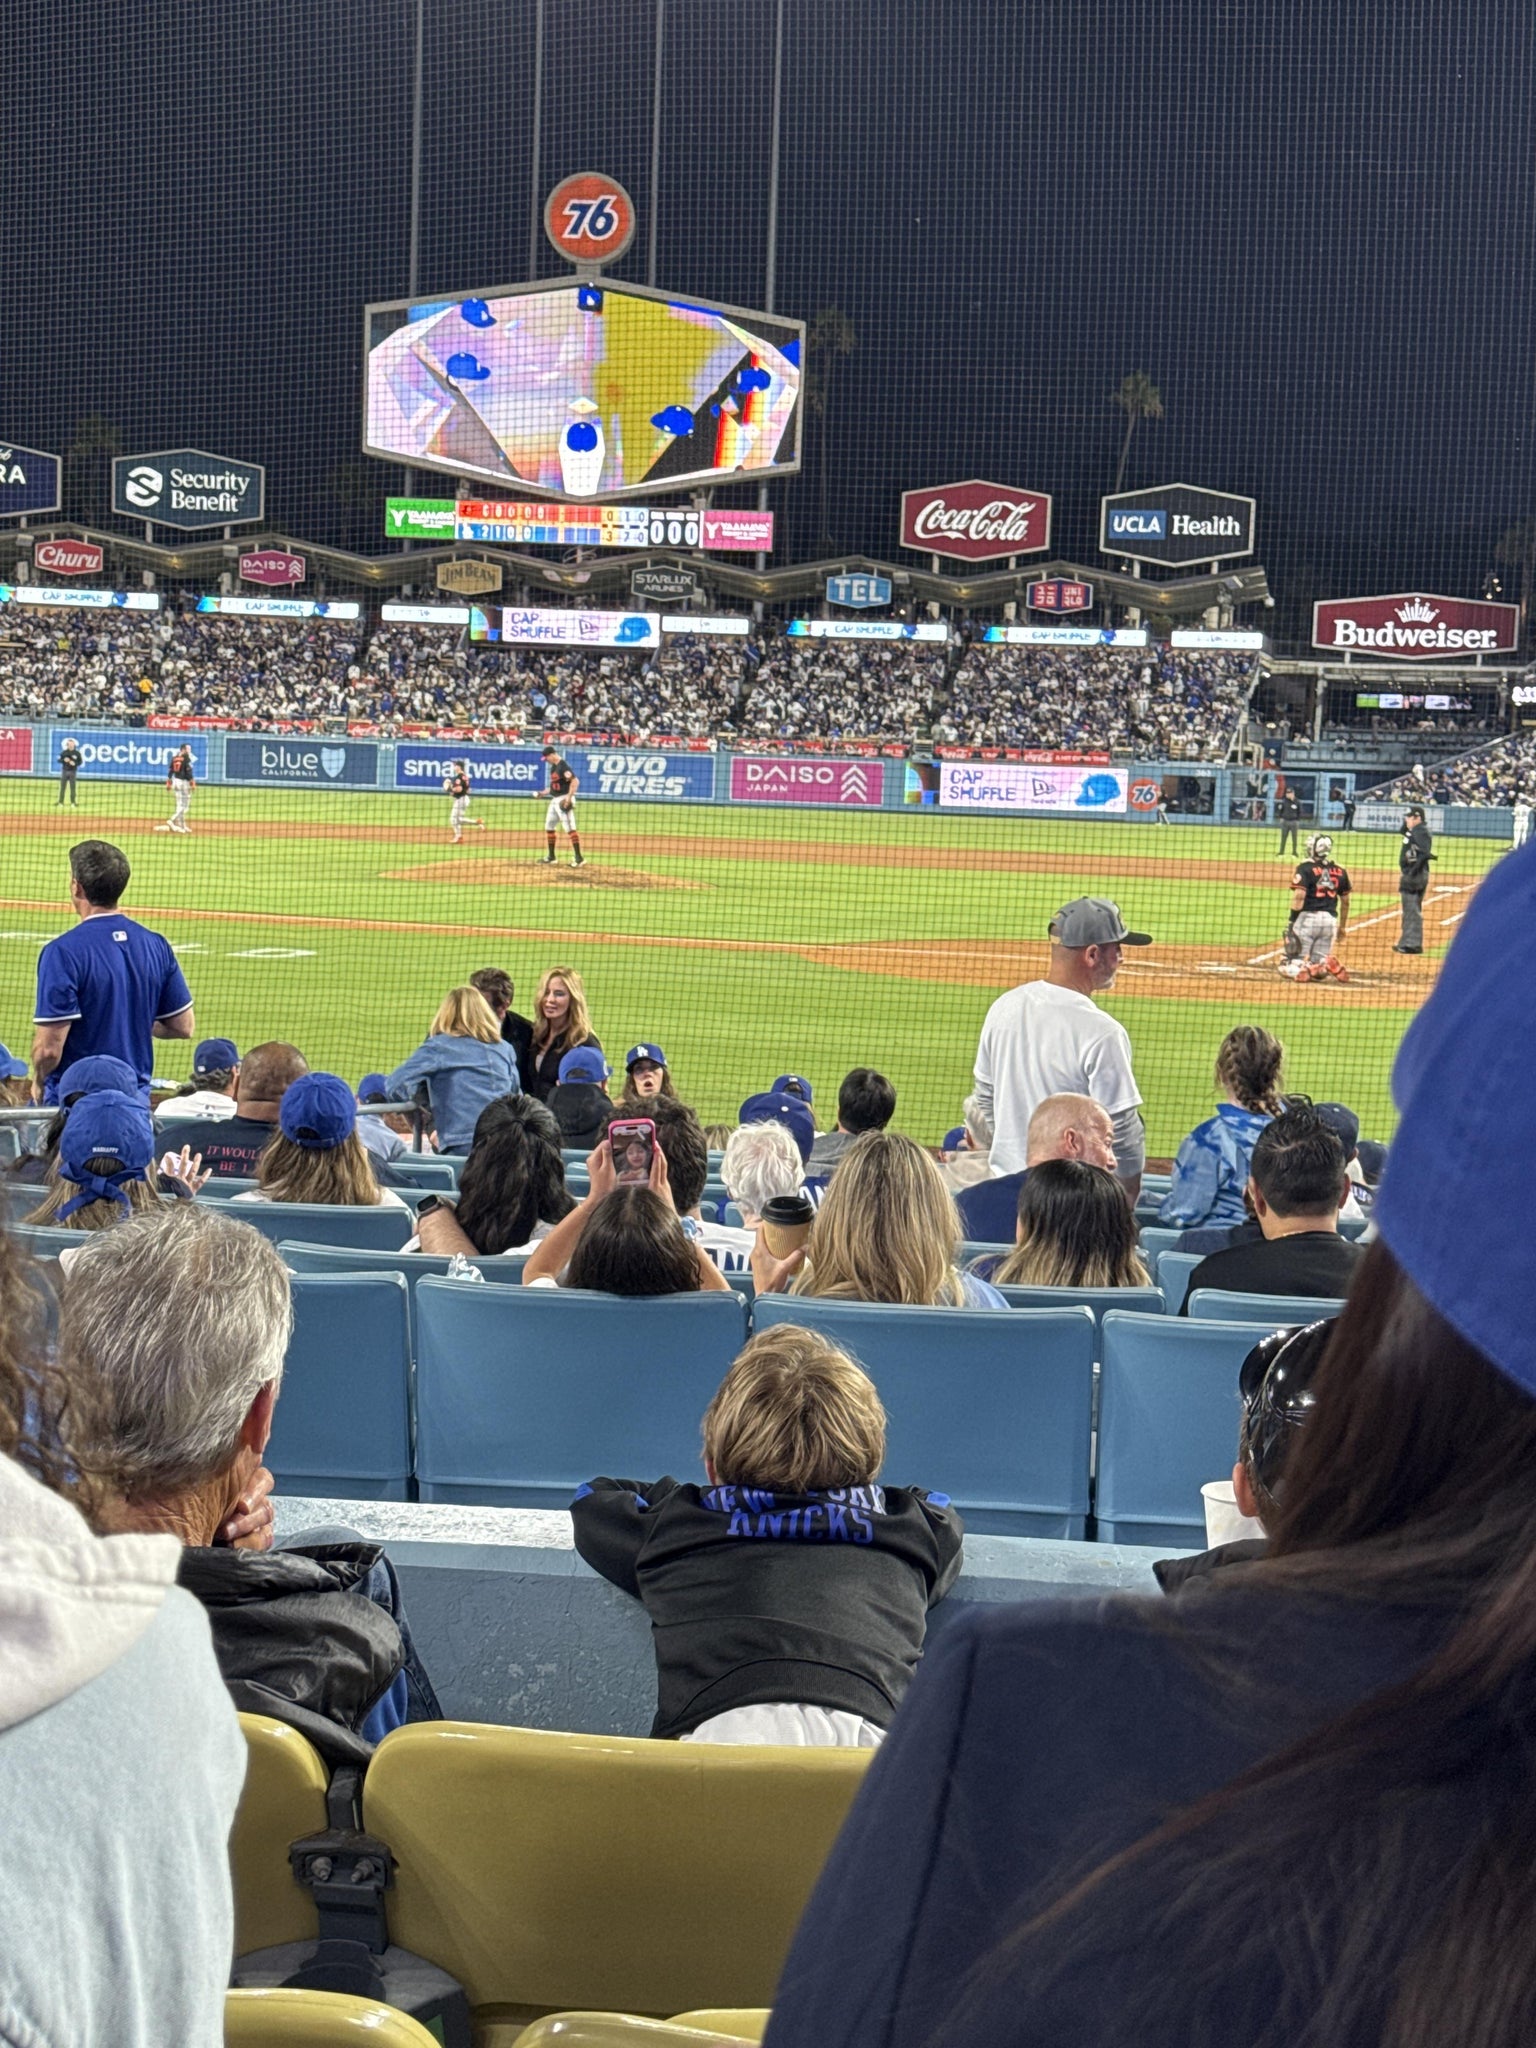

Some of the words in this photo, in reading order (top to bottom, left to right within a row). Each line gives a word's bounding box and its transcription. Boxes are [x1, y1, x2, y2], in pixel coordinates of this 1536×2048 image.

[563, 195, 617, 240] 76
[170, 467, 250, 494] Security
[171, 489, 239, 512] Benefit
[607, 510, 613, 521] 0
[624, 511, 630, 521] 1
[638, 511, 644, 522] 0
[914, 498, 1036, 543] Coca-Cola
[1113, 514, 1161, 535] UCLA
[1172, 513, 1241, 536] Health
[481, 526, 489, 537] 2
[496, 526, 501, 537] 1
[508, 526, 515, 538] 0
[606, 531, 613, 542] 3
[638, 532, 644, 542] 0
[650, 521, 664, 545] 0
[668, 521, 682, 545] 0
[685, 521, 699, 546] 0
[37, 546, 99, 569] Churu
[243, 560, 286, 570] DAISO
[441, 564, 464, 586] JIM
[464, 563, 496, 587] BEAM
[635, 573, 692, 586] STARLUX
[643, 584, 683, 593] AIRLINES
[834, 578, 883, 603] TEL
[511, 611, 540, 625] CAP
[510, 625, 566, 640] SHUFFLE
[262, 744, 318, 769] blue
[586, 754, 667, 775] TOYO
[262, 768, 319, 778] CALIFORNIA
[746, 764, 834, 785] DAISO
[950, 769, 984, 785] CAP
[599, 775, 687, 796] TIRES
[747, 783, 788, 793] JAPAN
[949, 785, 1016, 802] SHUFFLE
[1131, 786, 1156, 802] 76
[206, 1145, 219, 1155] IT
[221, 1146, 264, 1161] WOUL
[219, 1161, 235, 1171] BE
[806, 1484, 888, 1516] ORK
[726, 1502, 874, 1544] KNICKS
